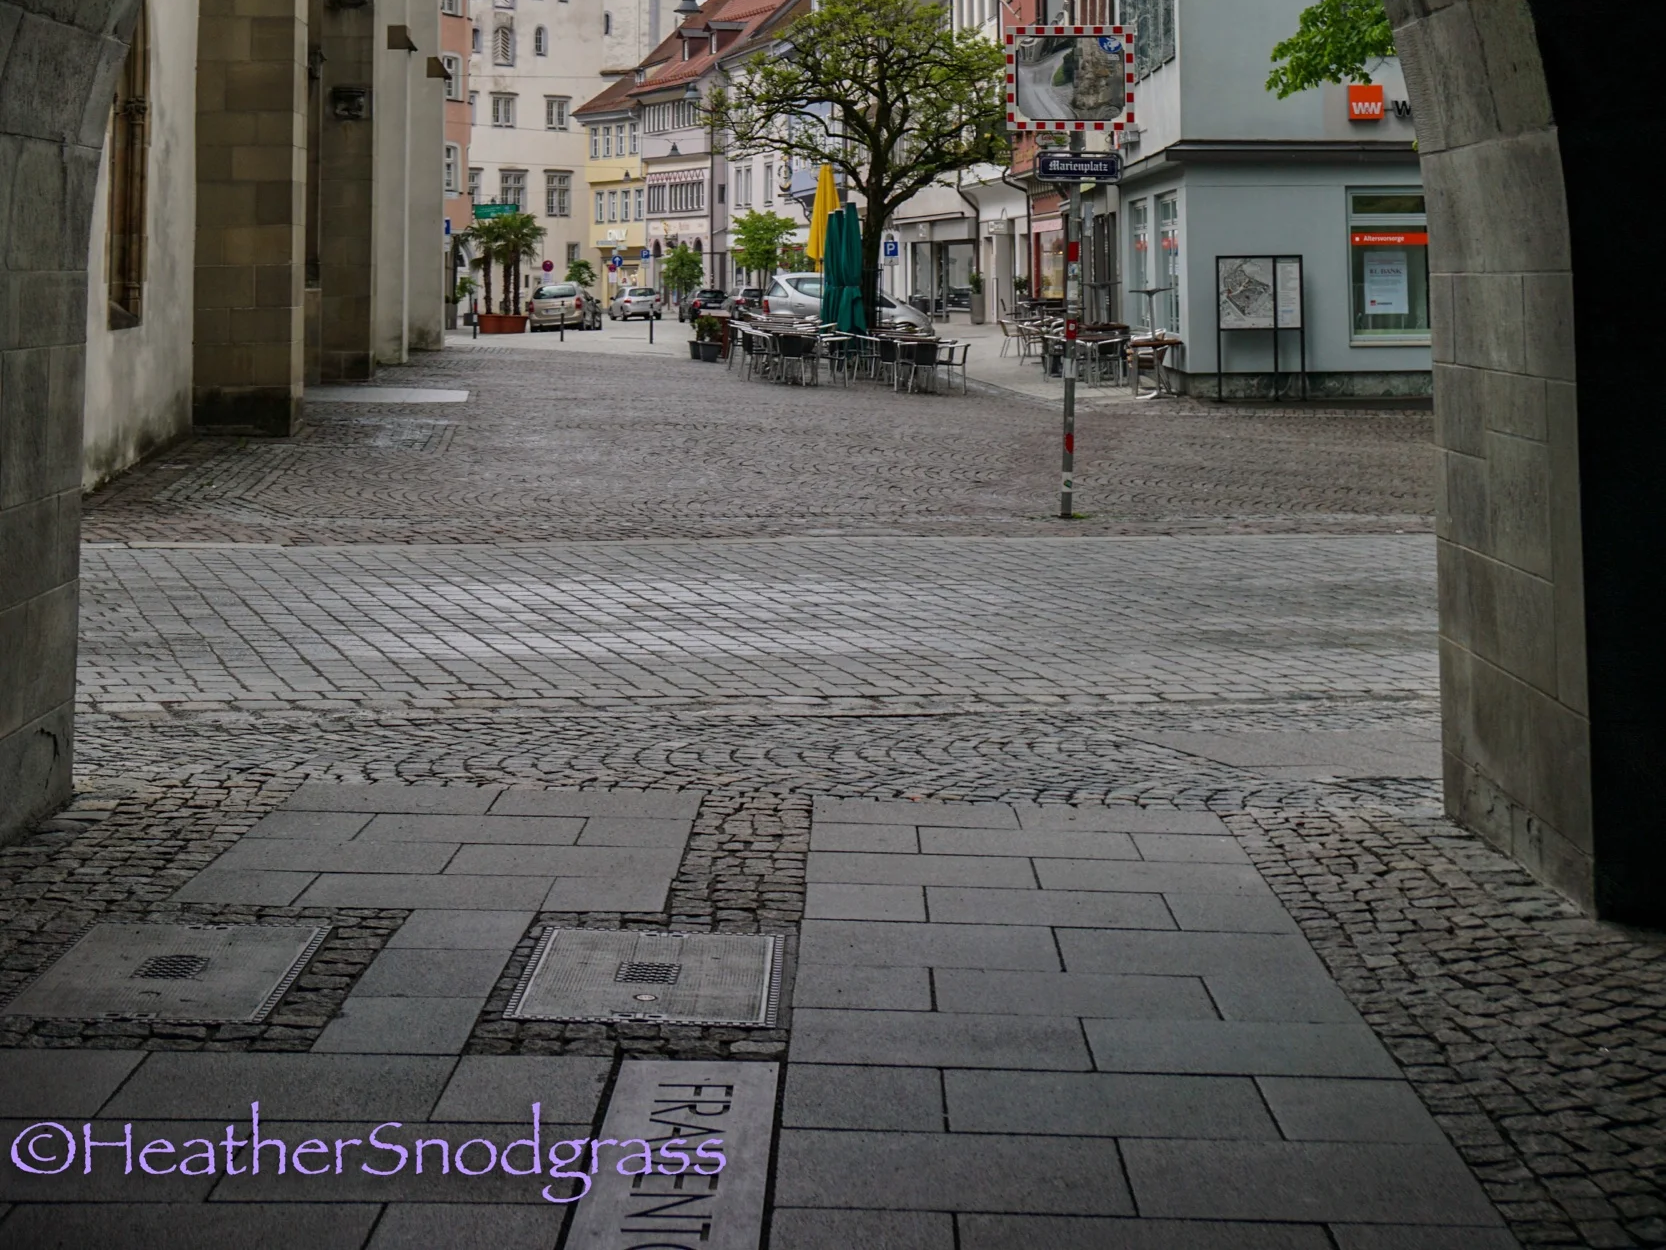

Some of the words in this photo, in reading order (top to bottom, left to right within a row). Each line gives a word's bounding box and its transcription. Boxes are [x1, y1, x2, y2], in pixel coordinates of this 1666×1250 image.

[1048, 160, 1108, 173] Marienplatz
[1363, 235, 1405, 243] Altersvorsorge
[886, 243, 896, 255] P
[620, 1084, 735, 1250] FRAUENT
